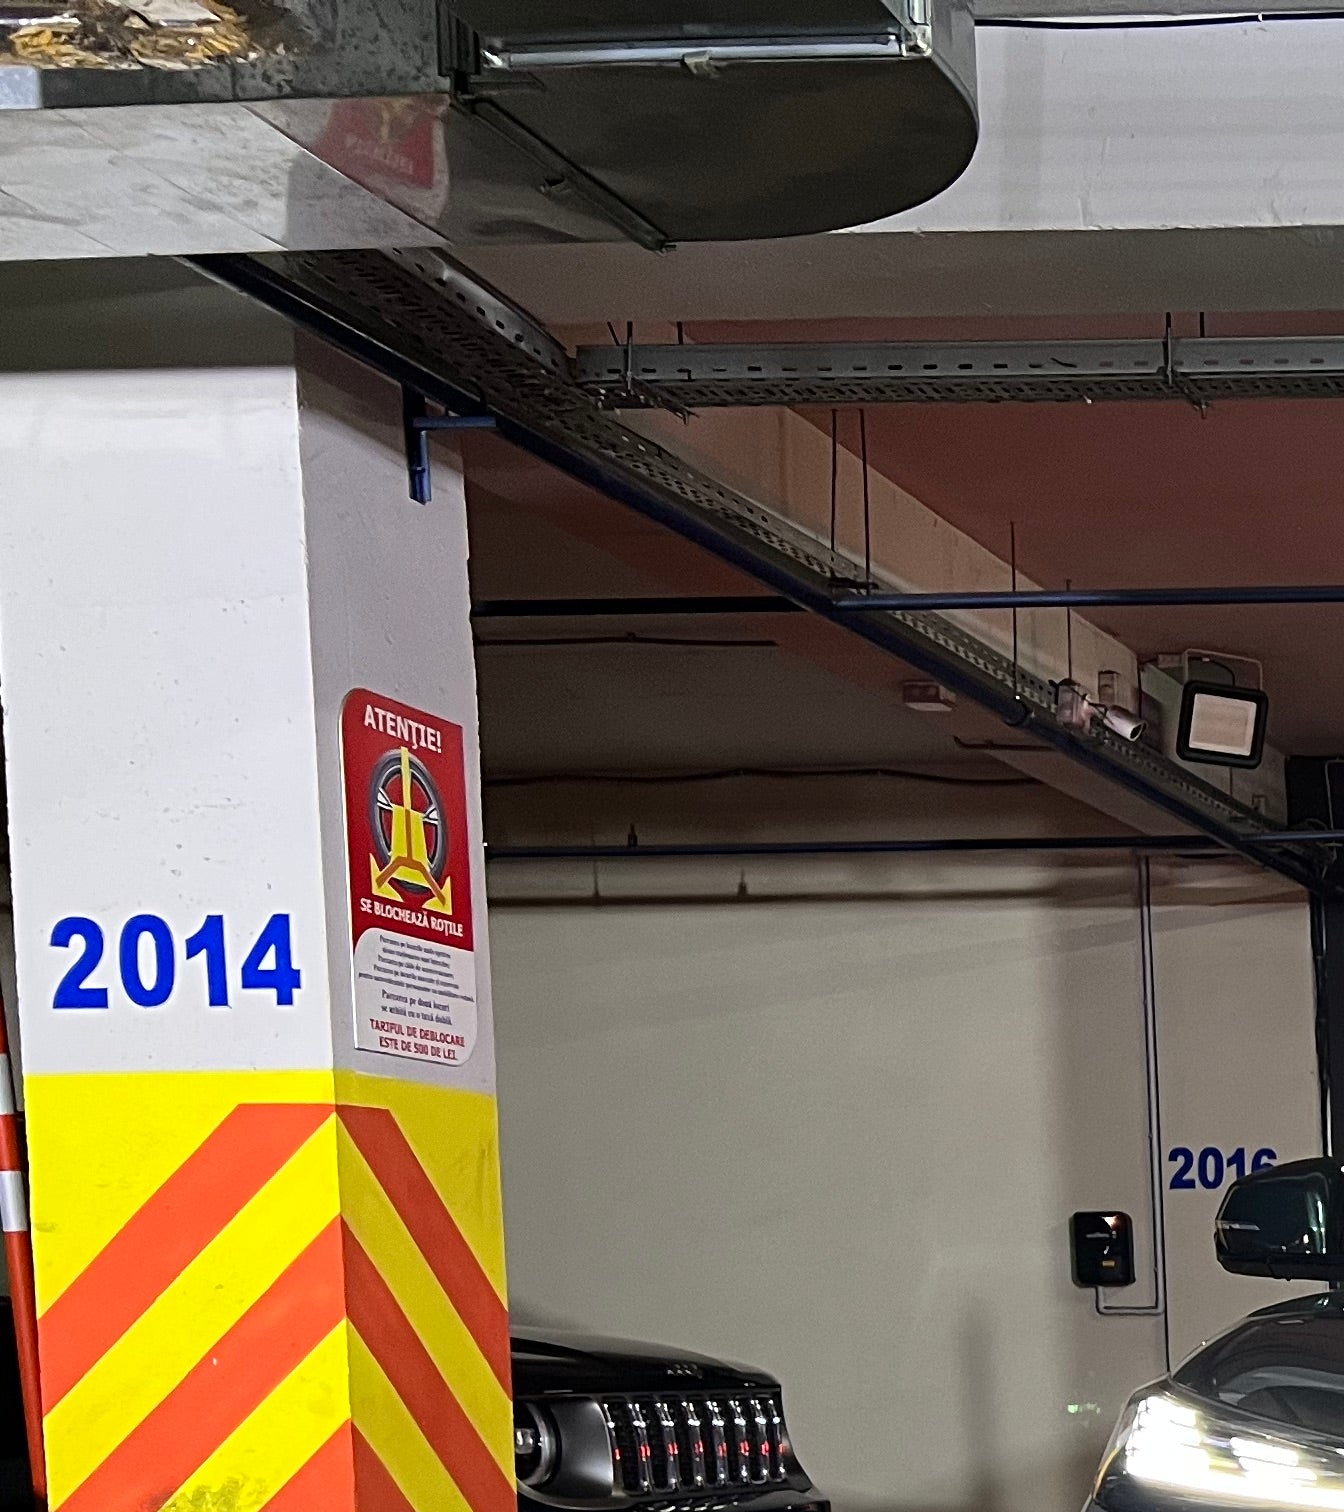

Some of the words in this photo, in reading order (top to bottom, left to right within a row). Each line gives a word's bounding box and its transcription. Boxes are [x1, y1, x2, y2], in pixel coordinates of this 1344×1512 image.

[360, 898, 373, 913] SE
[374, 901, 430, 929] BLOCHEAZĂ
[50, 914, 302, 1009] 2014
[370, 1018, 404, 1035] TARIFUL
[406, 1025, 418, 1038] DE
[420, 1028, 465, 1047] DEBLOCARE
[379, 1035, 399, 1050] ESTE
[400, 1039, 412, 1052] DE
[430, 1045, 442, 1058] DE
